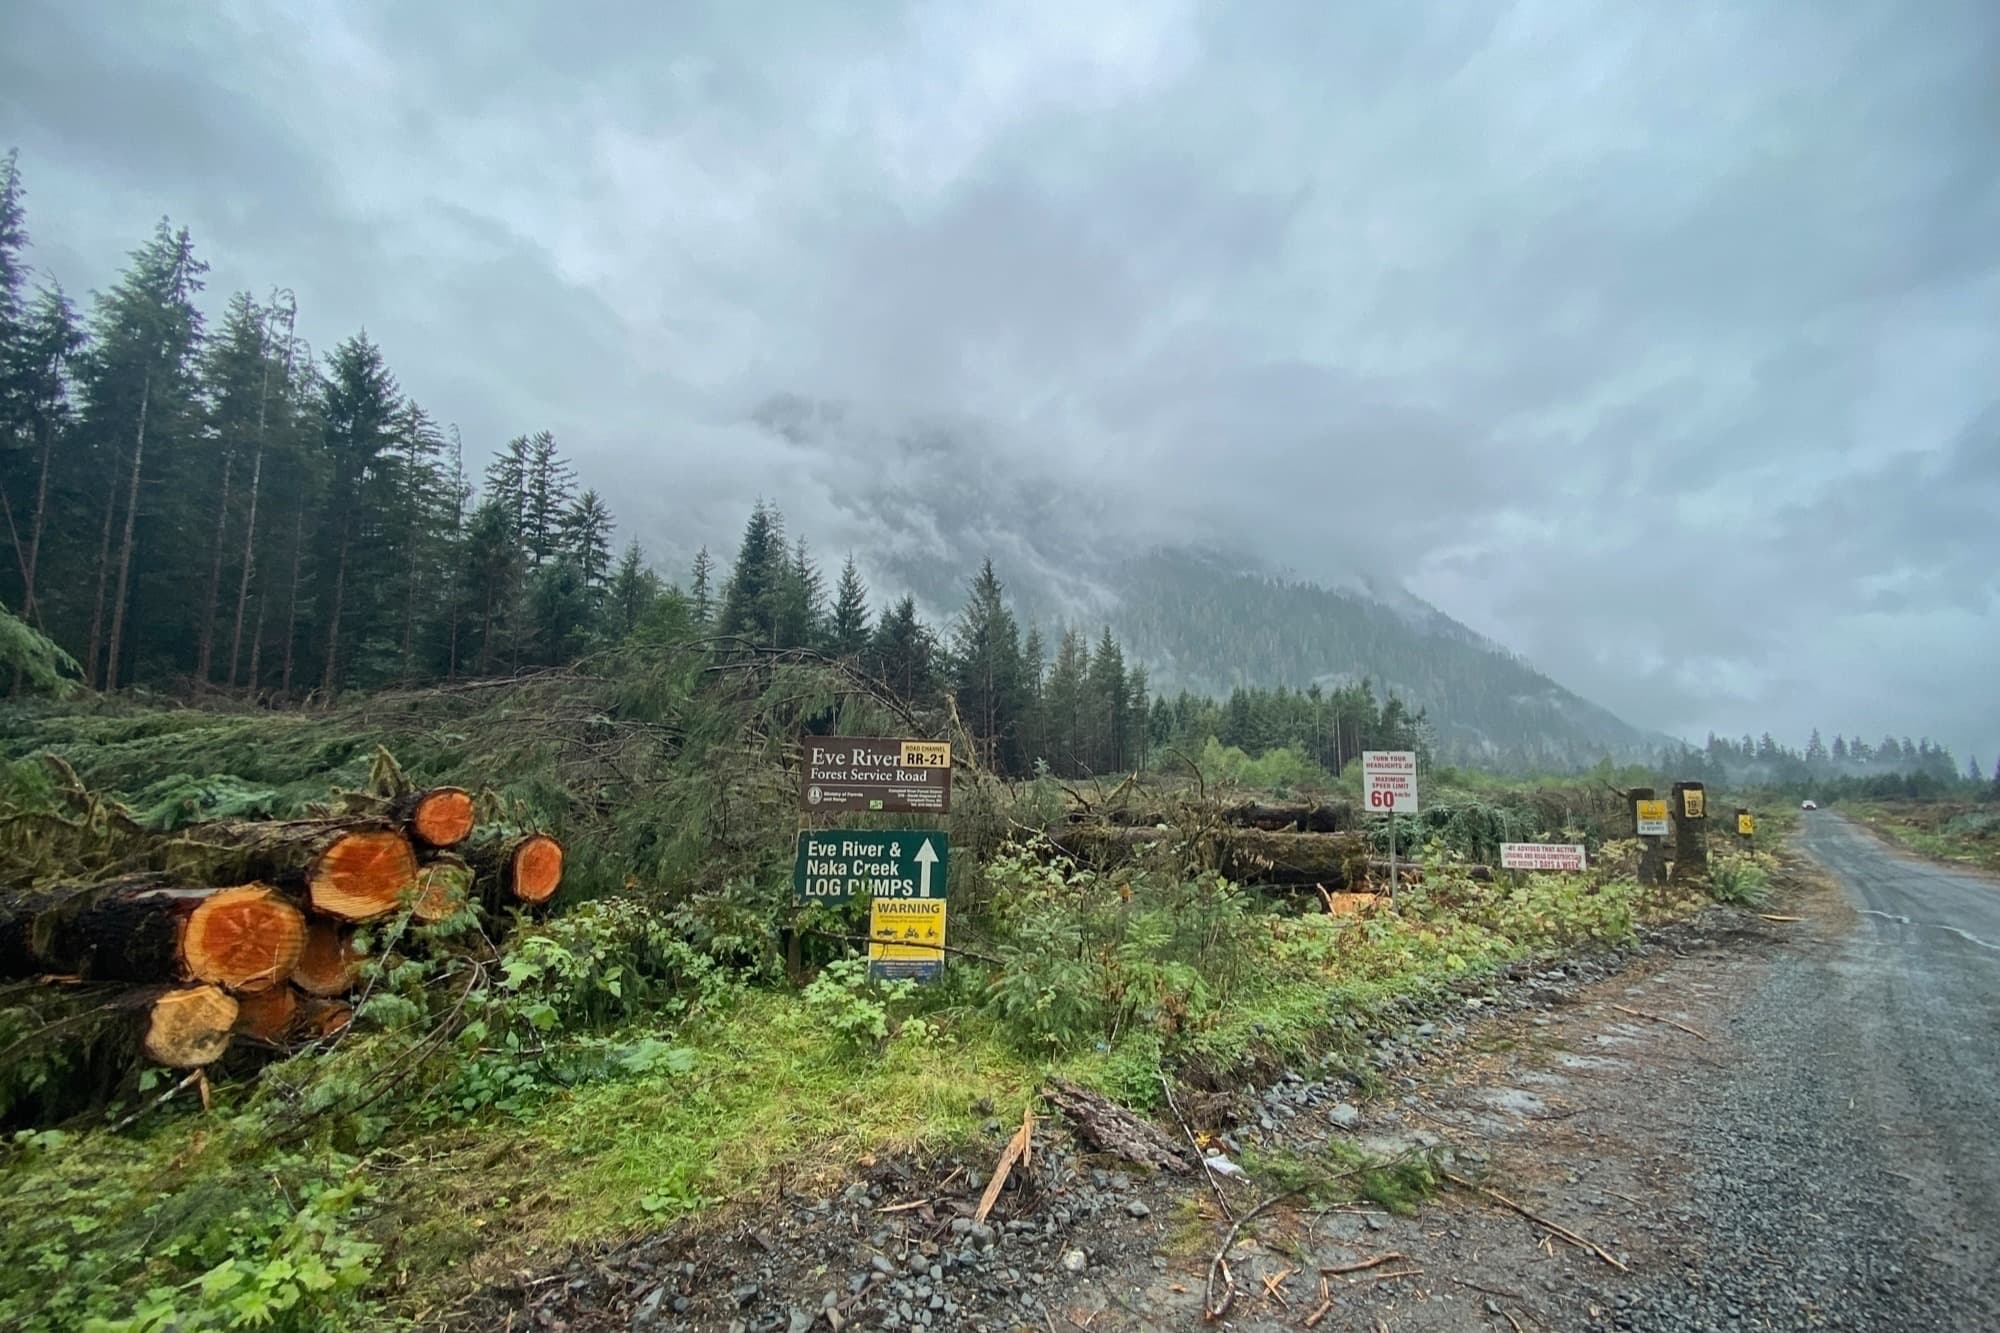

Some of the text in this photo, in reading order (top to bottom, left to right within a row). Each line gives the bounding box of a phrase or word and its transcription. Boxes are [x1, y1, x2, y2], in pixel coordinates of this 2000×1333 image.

[811, 748, 900, 766] Eve River
[907, 753, 944, 765] RR-21
[810, 768, 927, 782] Forest Service Road
[1371, 790, 1394, 807] 60
[808, 841, 902, 858] Eve River &
[806, 860, 899, 876] Naka Creek
[805, 878, 841, 896] LOG
[877, 903, 940, 914] WARNING
